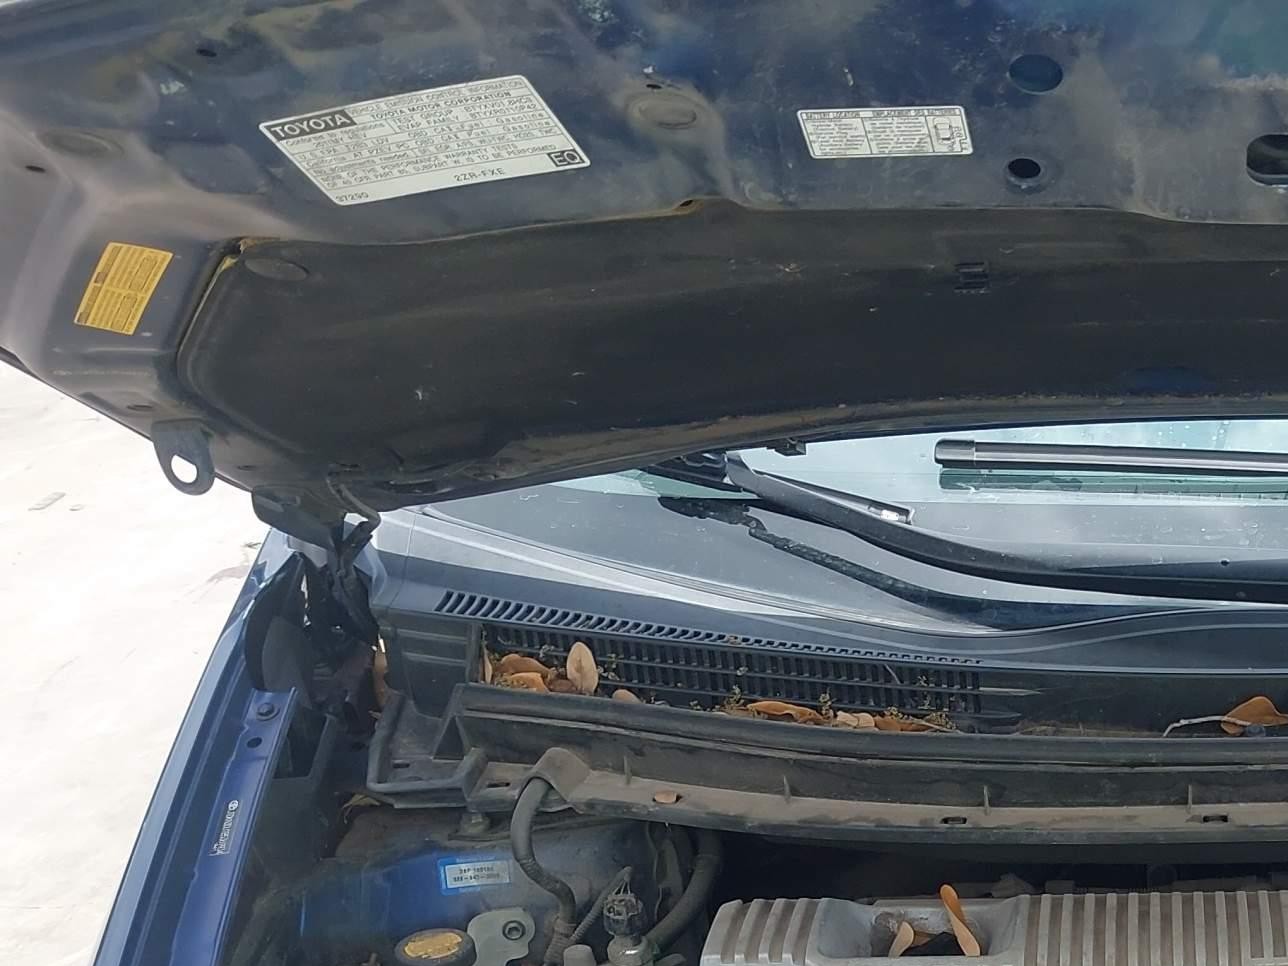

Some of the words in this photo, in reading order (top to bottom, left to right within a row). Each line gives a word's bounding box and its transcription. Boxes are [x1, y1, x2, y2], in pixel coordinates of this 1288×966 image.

[370, 110, 405, 120] TOYOTA
[407, 103, 443, 113] MOTOR
[444, 91, 511, 107] CORPORATION
[391, 116, 416, 125] TEST
[419, 109, 455, 120] GROUP
[425, 116, 461, 126] FAMILY
[495, 111, 544, 124] Gasoline
[271, 115, 351, 137] TOYOTA
[501, 119, 550, 132] Gasoline
[444, 148, 490, 160] WARRANTY
[506, 144, 557, 157] PERFORMED
[453, 168, 506, 181] 2ZR-FXE
